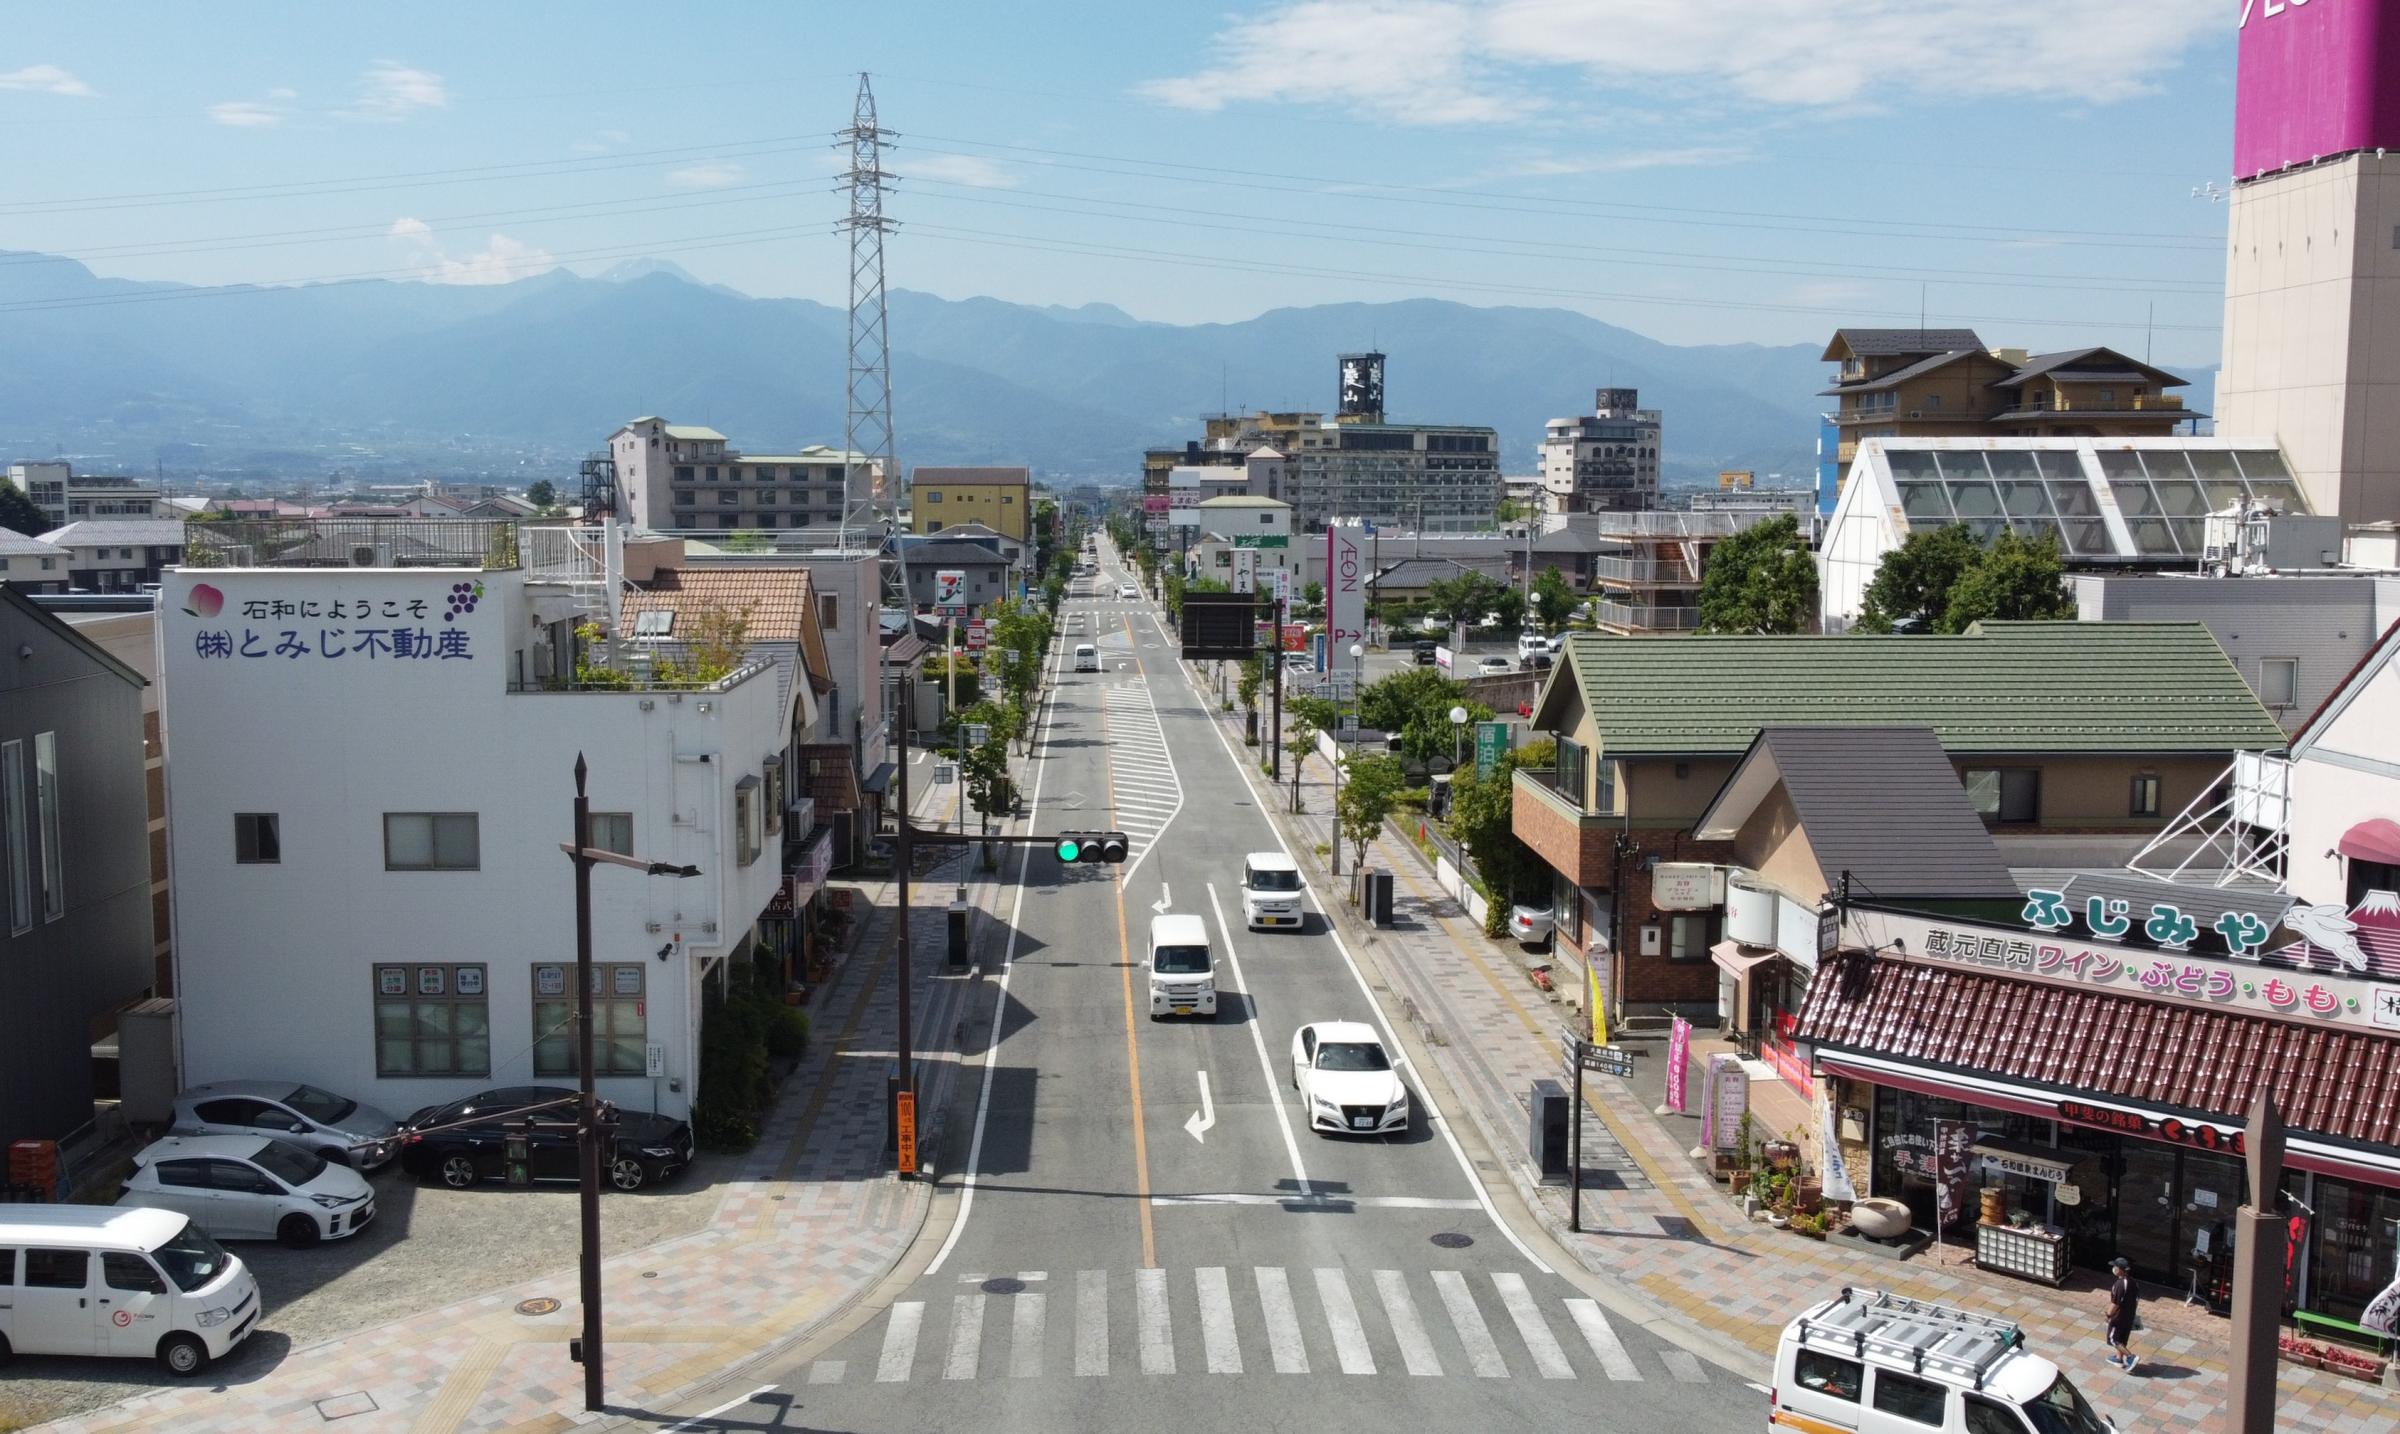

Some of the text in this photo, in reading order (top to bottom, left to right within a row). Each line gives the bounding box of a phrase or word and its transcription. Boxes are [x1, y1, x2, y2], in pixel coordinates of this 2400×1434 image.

[1343, 361, 1366, 402] 慶山
[242, 599, 429, 622] 石和にようこそ
[1335, 629, 1346, 643] P
[2021, 889, 2271, 954] ふじみや
[1881, 1133, 1938, 1151] ご自由にお使い下
